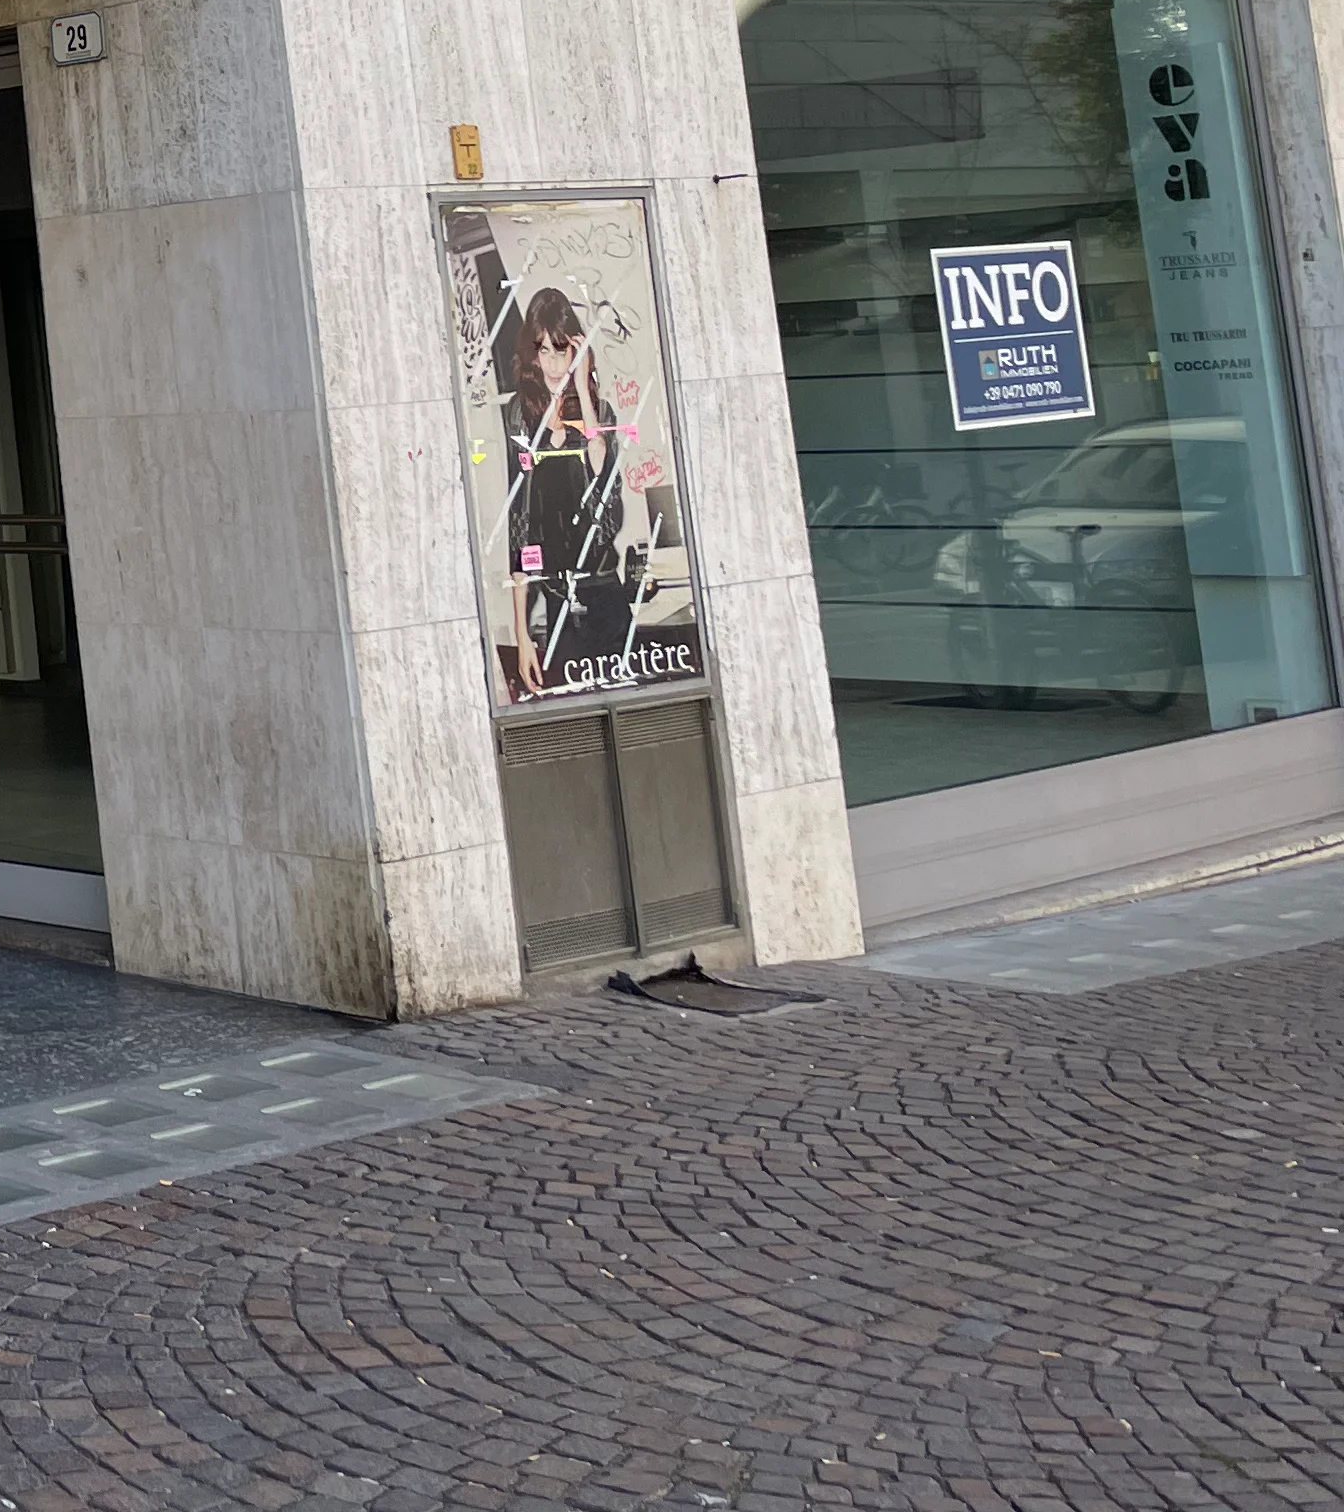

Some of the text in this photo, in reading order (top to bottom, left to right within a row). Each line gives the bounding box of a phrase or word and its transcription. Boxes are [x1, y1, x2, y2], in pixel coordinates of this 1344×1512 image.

[66, 24, 87, 51] 29
[1158, 252, 1236, 268] TRUSSARDI
[1169, 268, 1229, 281] JEANS
[943, 260, 1069, 330] INFO
[997, 344, 1057, 367] RUTH
[1174, 358, 1251, 372] COCCAPANI
[1000, 364, 1059, 378] IMMOBILIEN
[984, 380, 1062, 400] +39 0471 090 790
[564, 641, 691, 685] caractère
